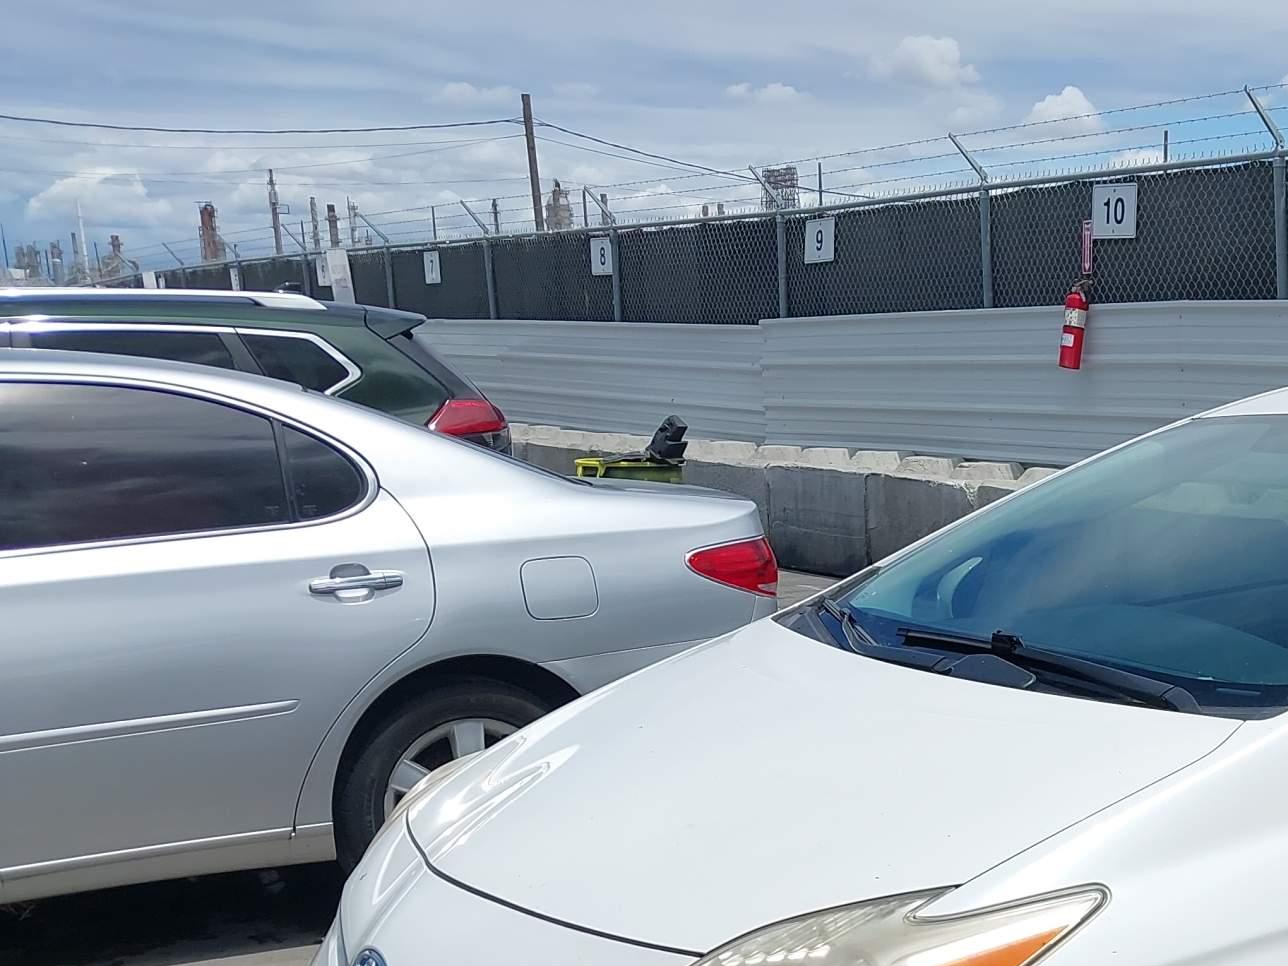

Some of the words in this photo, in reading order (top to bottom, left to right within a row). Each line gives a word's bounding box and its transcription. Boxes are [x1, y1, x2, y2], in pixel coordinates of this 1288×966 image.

[1103, 197, 1125, 225] 10
[815, 229, 824, 252] 9
[599, 246, 606, 266] 8
